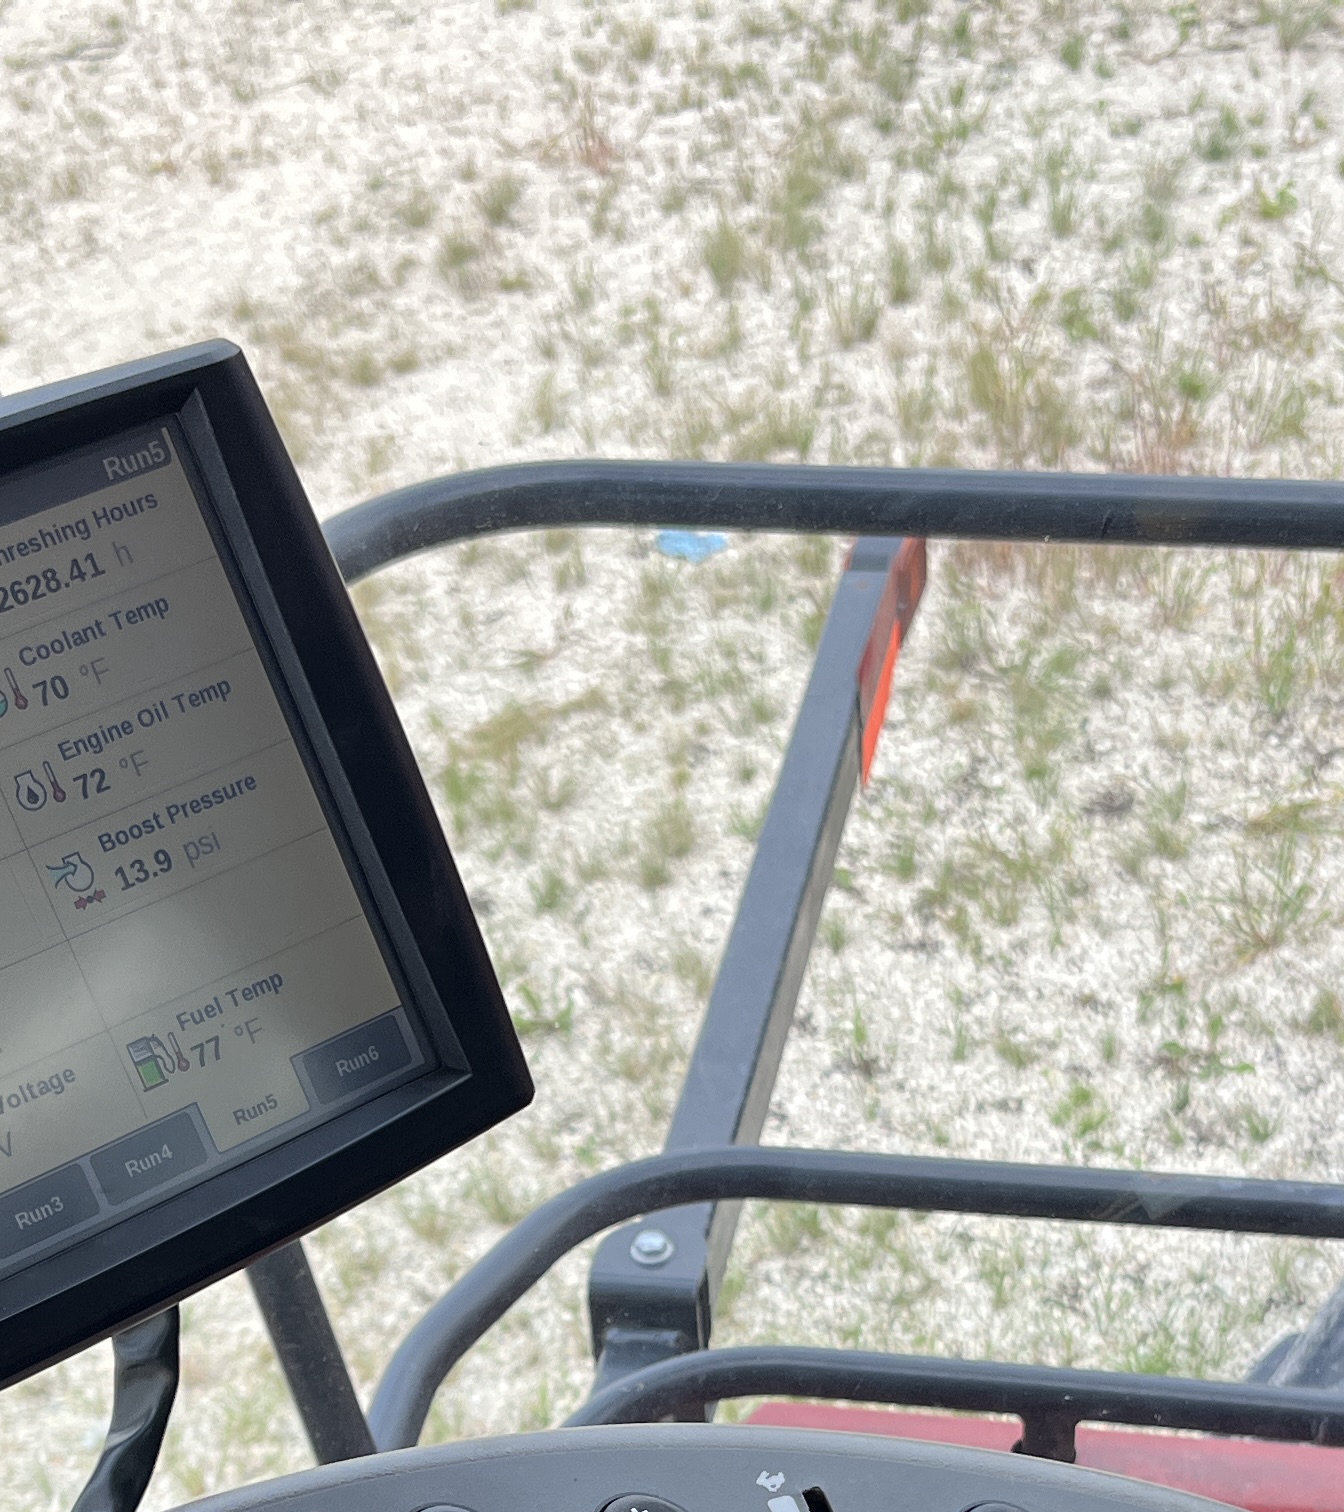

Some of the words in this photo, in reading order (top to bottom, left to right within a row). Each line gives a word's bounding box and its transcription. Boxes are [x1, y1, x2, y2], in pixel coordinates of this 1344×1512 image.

[102, 440, 166, 481] Run5
[92, 493, 159, 529] Hours
[112, 541, 134, 567] h
[19, 618, 106, 667] Coolant
[108, 597, 169, 631] Temp
[32, 675, 70, 707] 70
[57, 720, 134, 762] Engine
[137, 700, 170, 729] Oil
[171, 679, 232, 714] Temp
[73, 767, 111, 800] 72
[97, 812, 165, 853] Boost
[165, 775, 257, 825] Pressure
[114, 848, 173, 892] 13.9
[182, 830, 222, 868] psi
[176, 997, 224, 1032] Fuel
[225, 973, 284, 1008] Temp
[189, 1035, 222, 1068] 77
[335, 1045, 380, 1077] Run6
[232, 1093, 278, 1126] Run5
[124, 1143, 174, 1179] Run4
[14, 1196, 66, 1231] Run3
